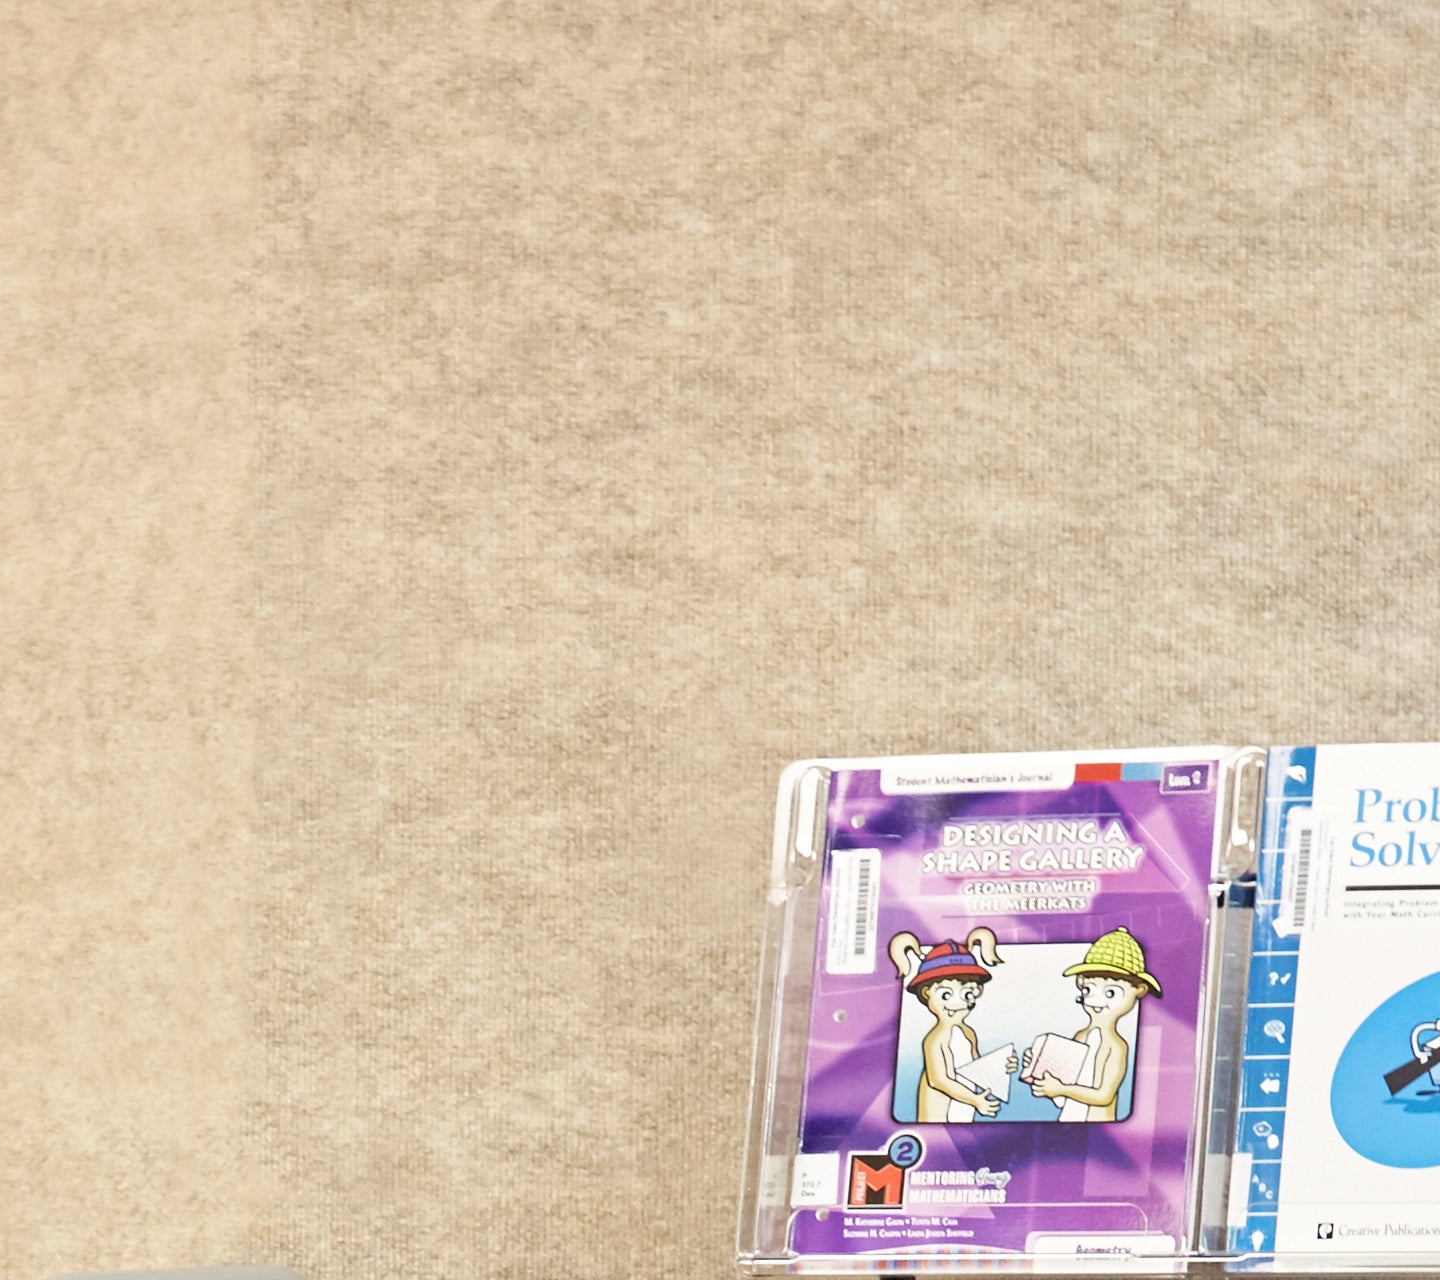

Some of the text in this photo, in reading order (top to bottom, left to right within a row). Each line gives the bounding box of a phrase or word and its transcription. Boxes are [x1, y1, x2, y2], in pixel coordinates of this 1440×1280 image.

[943, 821, 1127, 846] DESIGNING A
[922, 847, 1143, 873] SHAPE GALLERY
[963, 880, 1096, 895] GEOMETRY WITH
[972, 897, 1087, 911] THE MEERKATS
[910, 1171, 974, 1185] MENTORING
[908, 1189, 1006, 1203] MATHEMATICIANS
[1338, 1224, 1381, 1237] Creative
